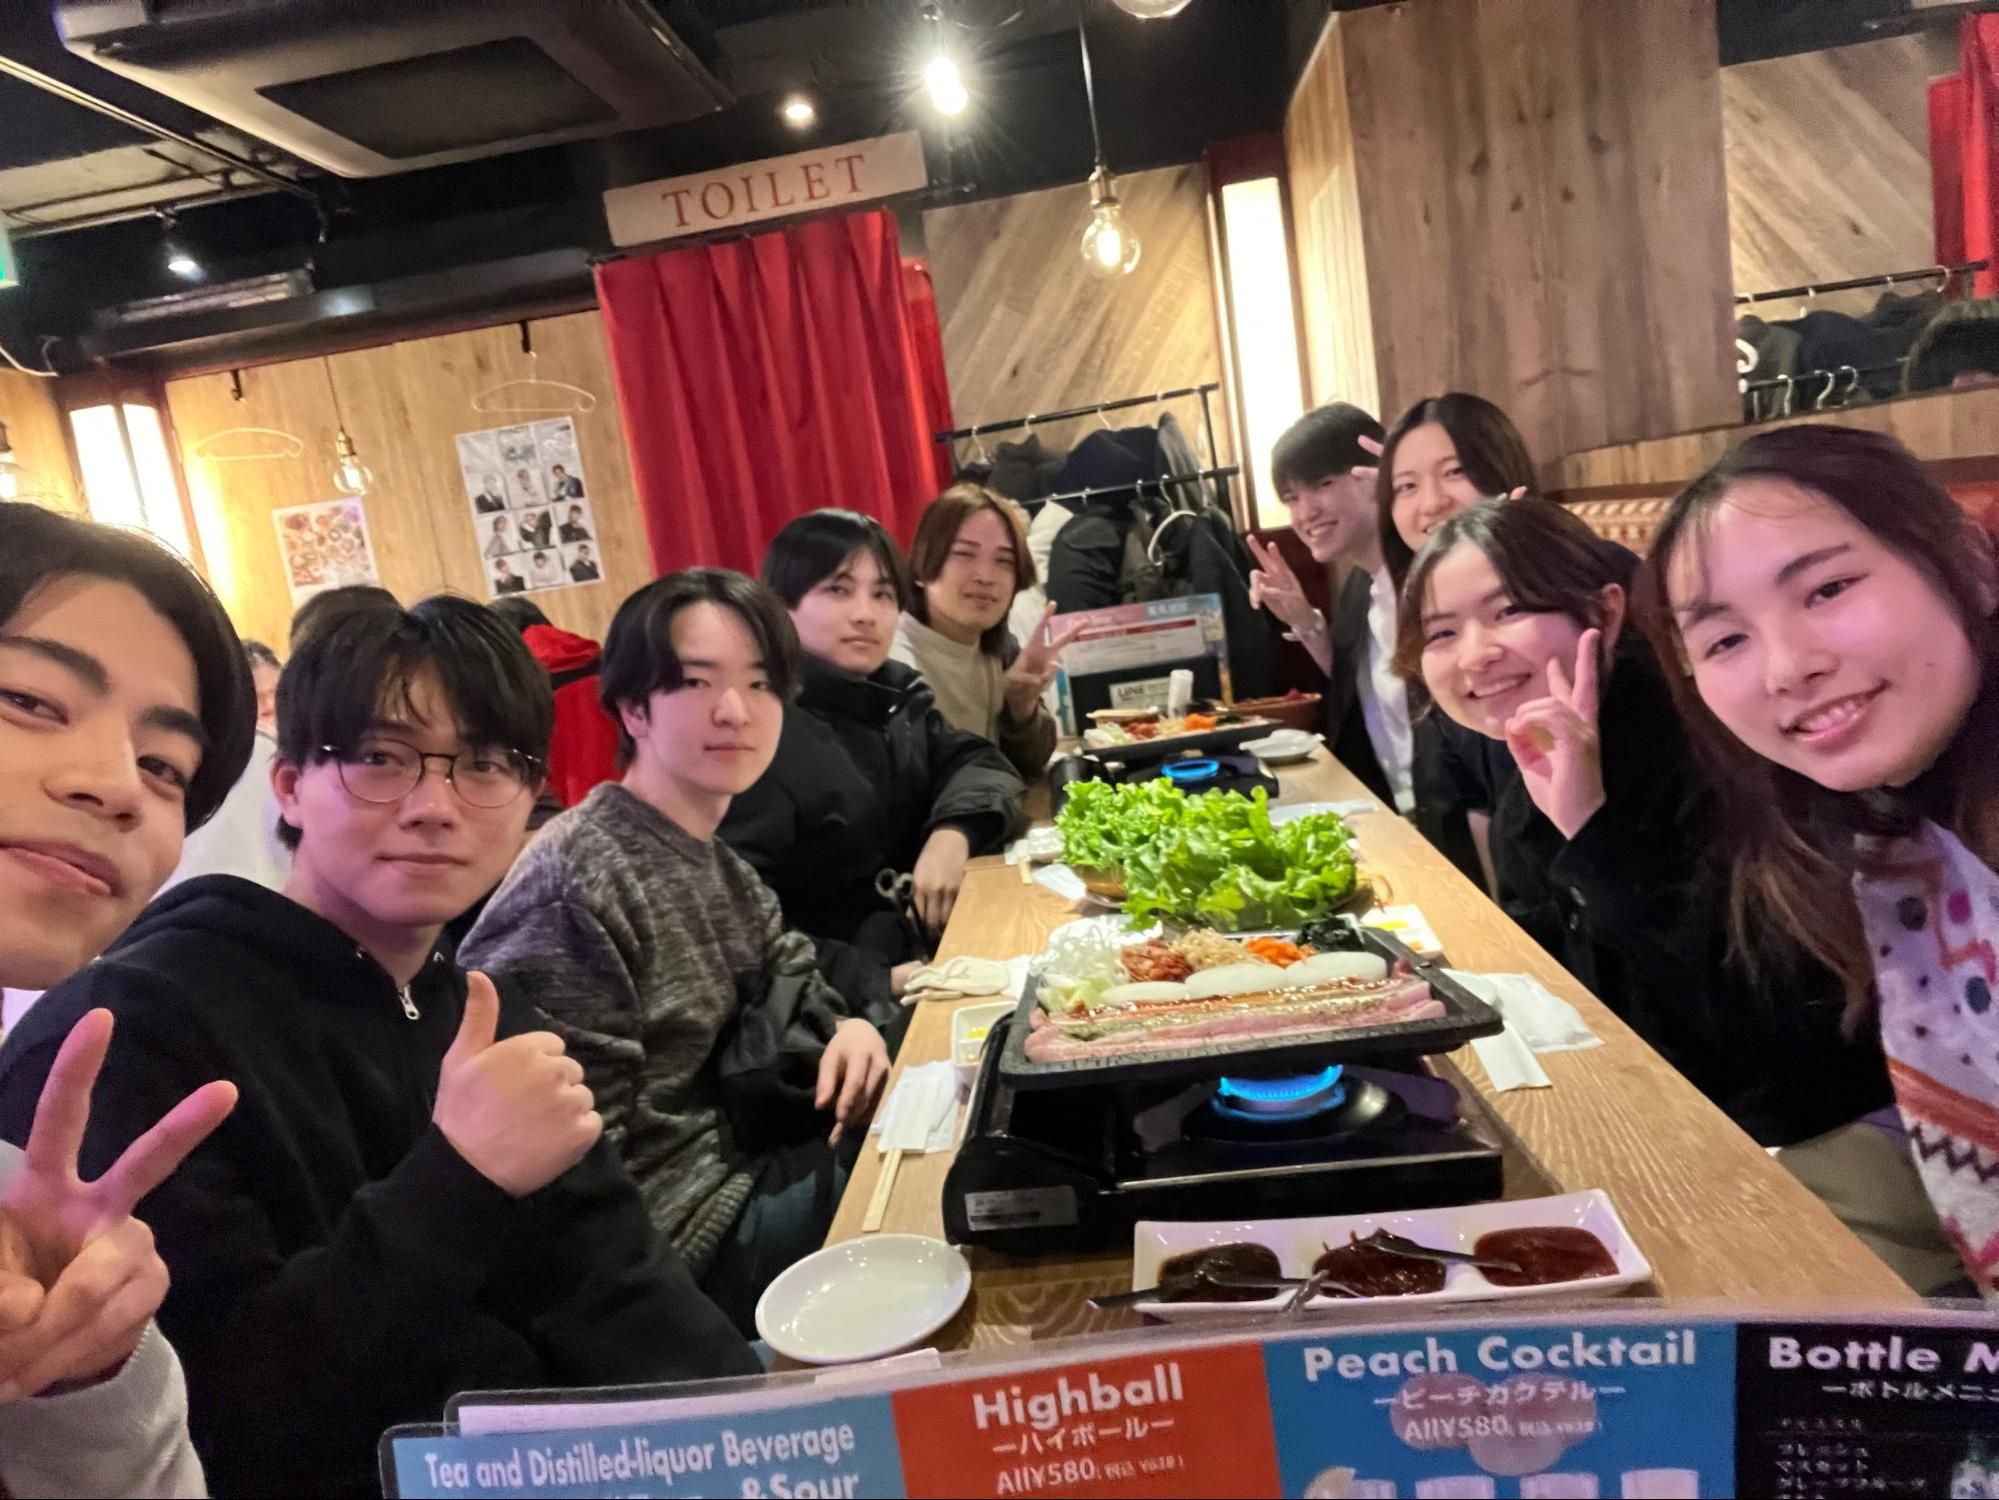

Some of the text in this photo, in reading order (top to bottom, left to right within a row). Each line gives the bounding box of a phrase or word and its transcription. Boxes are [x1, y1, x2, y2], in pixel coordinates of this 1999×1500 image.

[662, 154, 865, 227] TOILET
[1303, 1330, 1696, 1382] Peach Cocktail
[1769, 1336, 1941, 1372] Bottle
[972, 1362, 1184, 1430] Highball
[424, 1423, 856, 1488] Tea and Distilled-liquor Beverage
[769, 1472, 859, 1499] Sour
